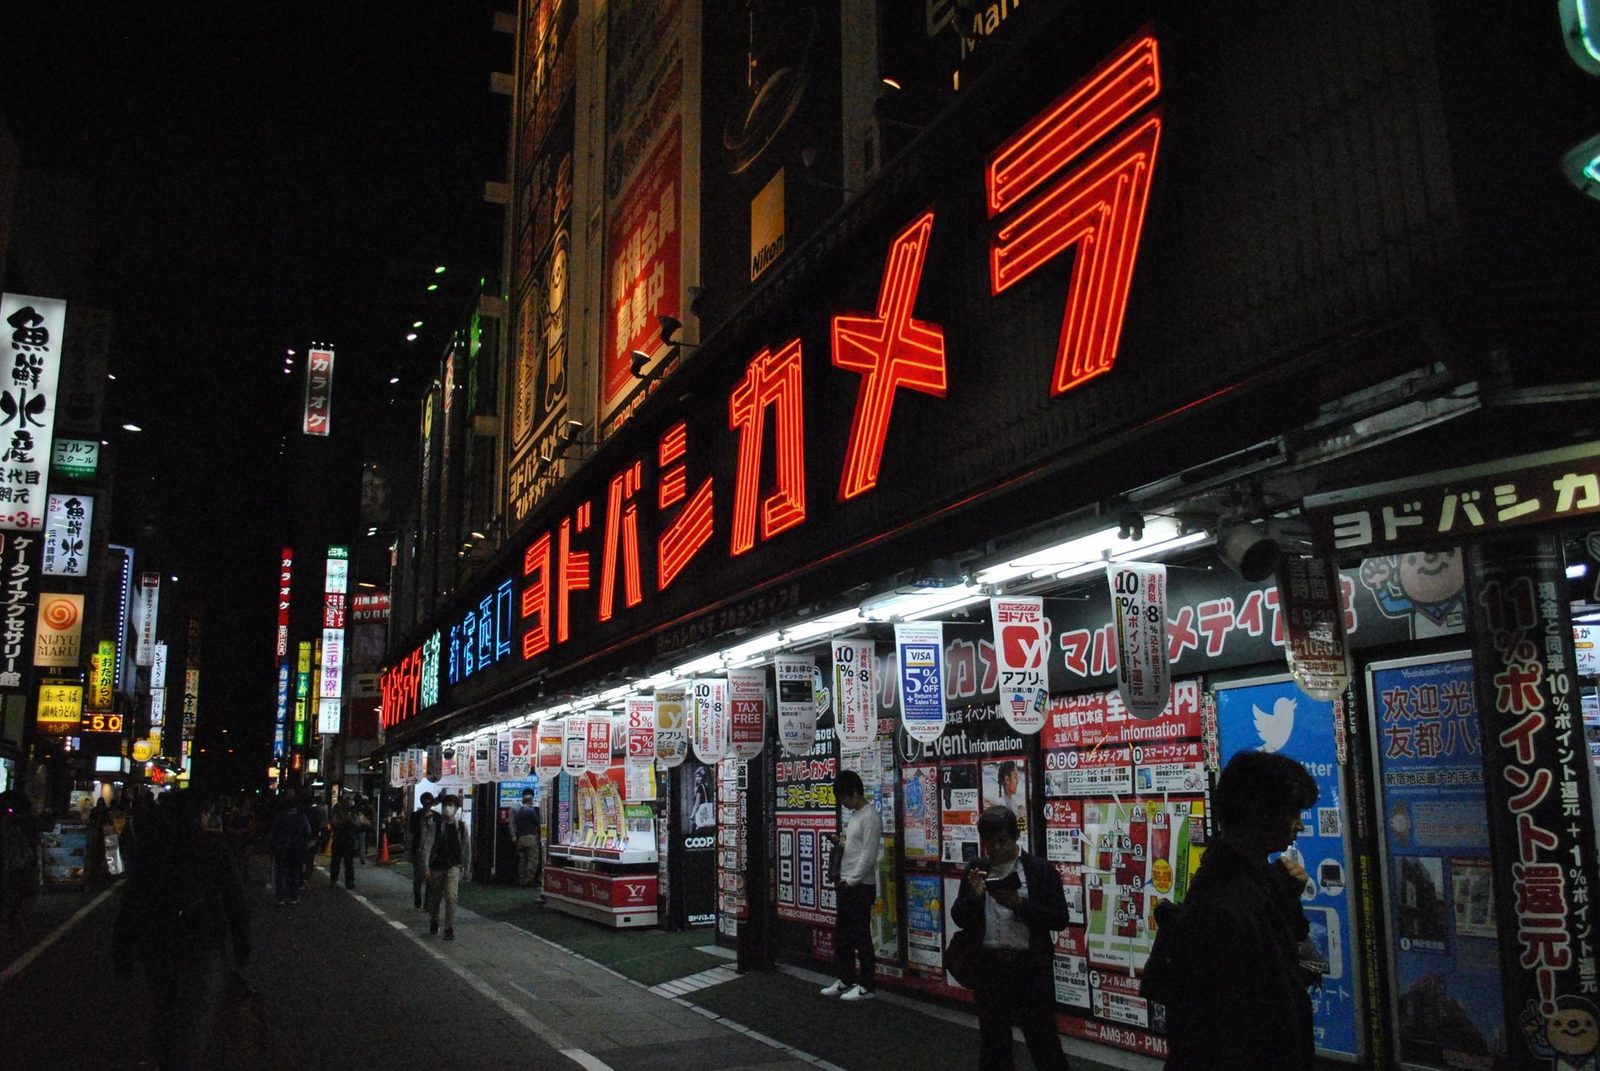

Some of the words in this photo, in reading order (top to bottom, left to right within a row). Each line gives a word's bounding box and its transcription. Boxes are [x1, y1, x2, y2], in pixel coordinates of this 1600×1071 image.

[752, 235, 785, 275] Nikon
[522, 34, 1162, 661] ヨドバシカメラ
[308, 358, 329, 427] カラオケ
[57, 442, 95, 454] ゴルフ
[58, 455, 94, 464] スクール
[1333, 473, 1600, 549] ヨドバシカ
[280, 559, 292, 609] カラオケ
[0, 536, 34, 687] ケータイアクセサリー館
[998, 612, 1040, 623] ヨドバシ
[38, 634, 79, 646] NIJYU
[38, 645, 78, 657] MARU
[911, 651, 932, 660] VISA
[100, 657, 113, 707] おたからや
[922, 685, 939, 693] OFF
[44, 690, 79, 703] 生そば
[1105, 680, 1199, 722] 全内
[1381, 680, 1479, 721] 欢迎光
[736, 702, 758, 713] TAX
[734, 714, 761, 723] FREE
[1053, 709, 1104, 729] 新宿西口本店
[1120, 721, 1186, 741] information
[1385, 718, 1481, 760] 友都八
[923, 729, 968, 757] Event
[969, 736, 1023, 754] Information
[776, 758, 836, 782] ヨドバシカメラ
[684, 837, 715, 848] COOP
[1100, 1025, 1136, 1047] AM9:30
